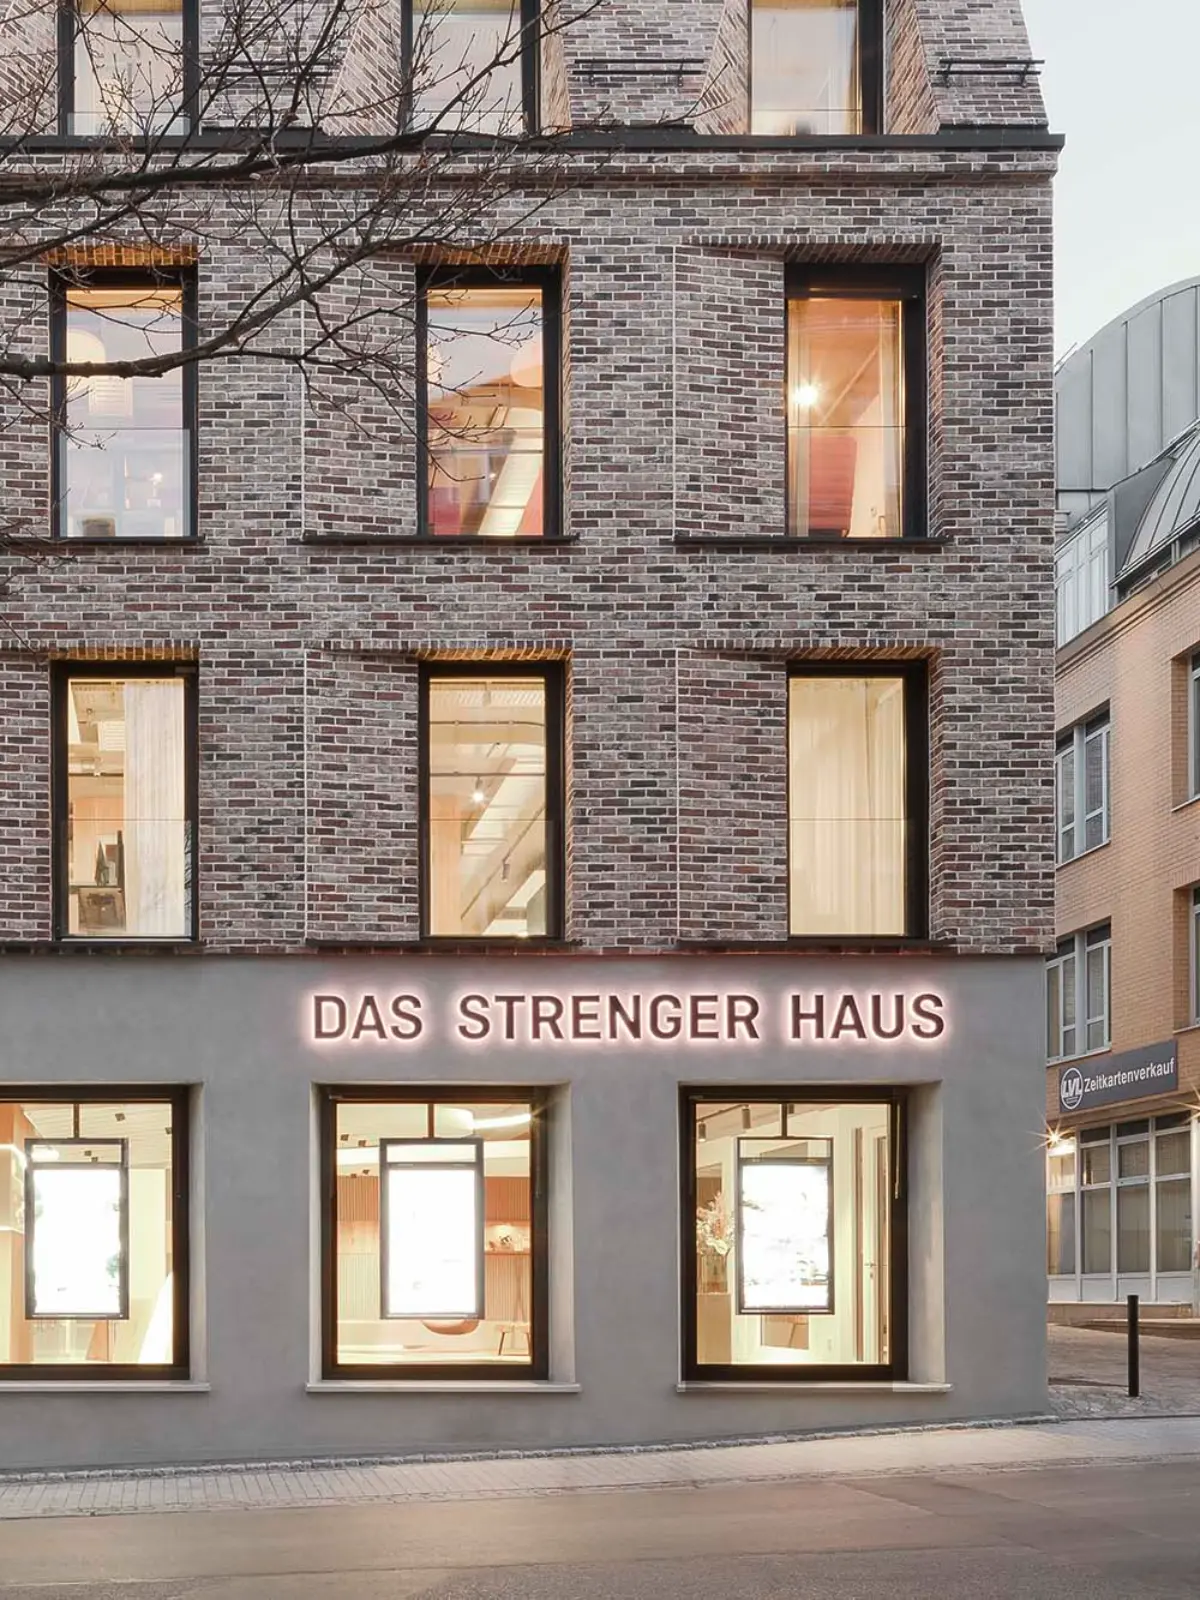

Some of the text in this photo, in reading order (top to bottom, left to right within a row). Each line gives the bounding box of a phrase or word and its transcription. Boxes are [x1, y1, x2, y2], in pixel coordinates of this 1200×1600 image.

[313, 994, 946, 1040] DAS STRENGER HAUS
[1084, 1057, 1175, 1093] Zeitkartenverkauf
